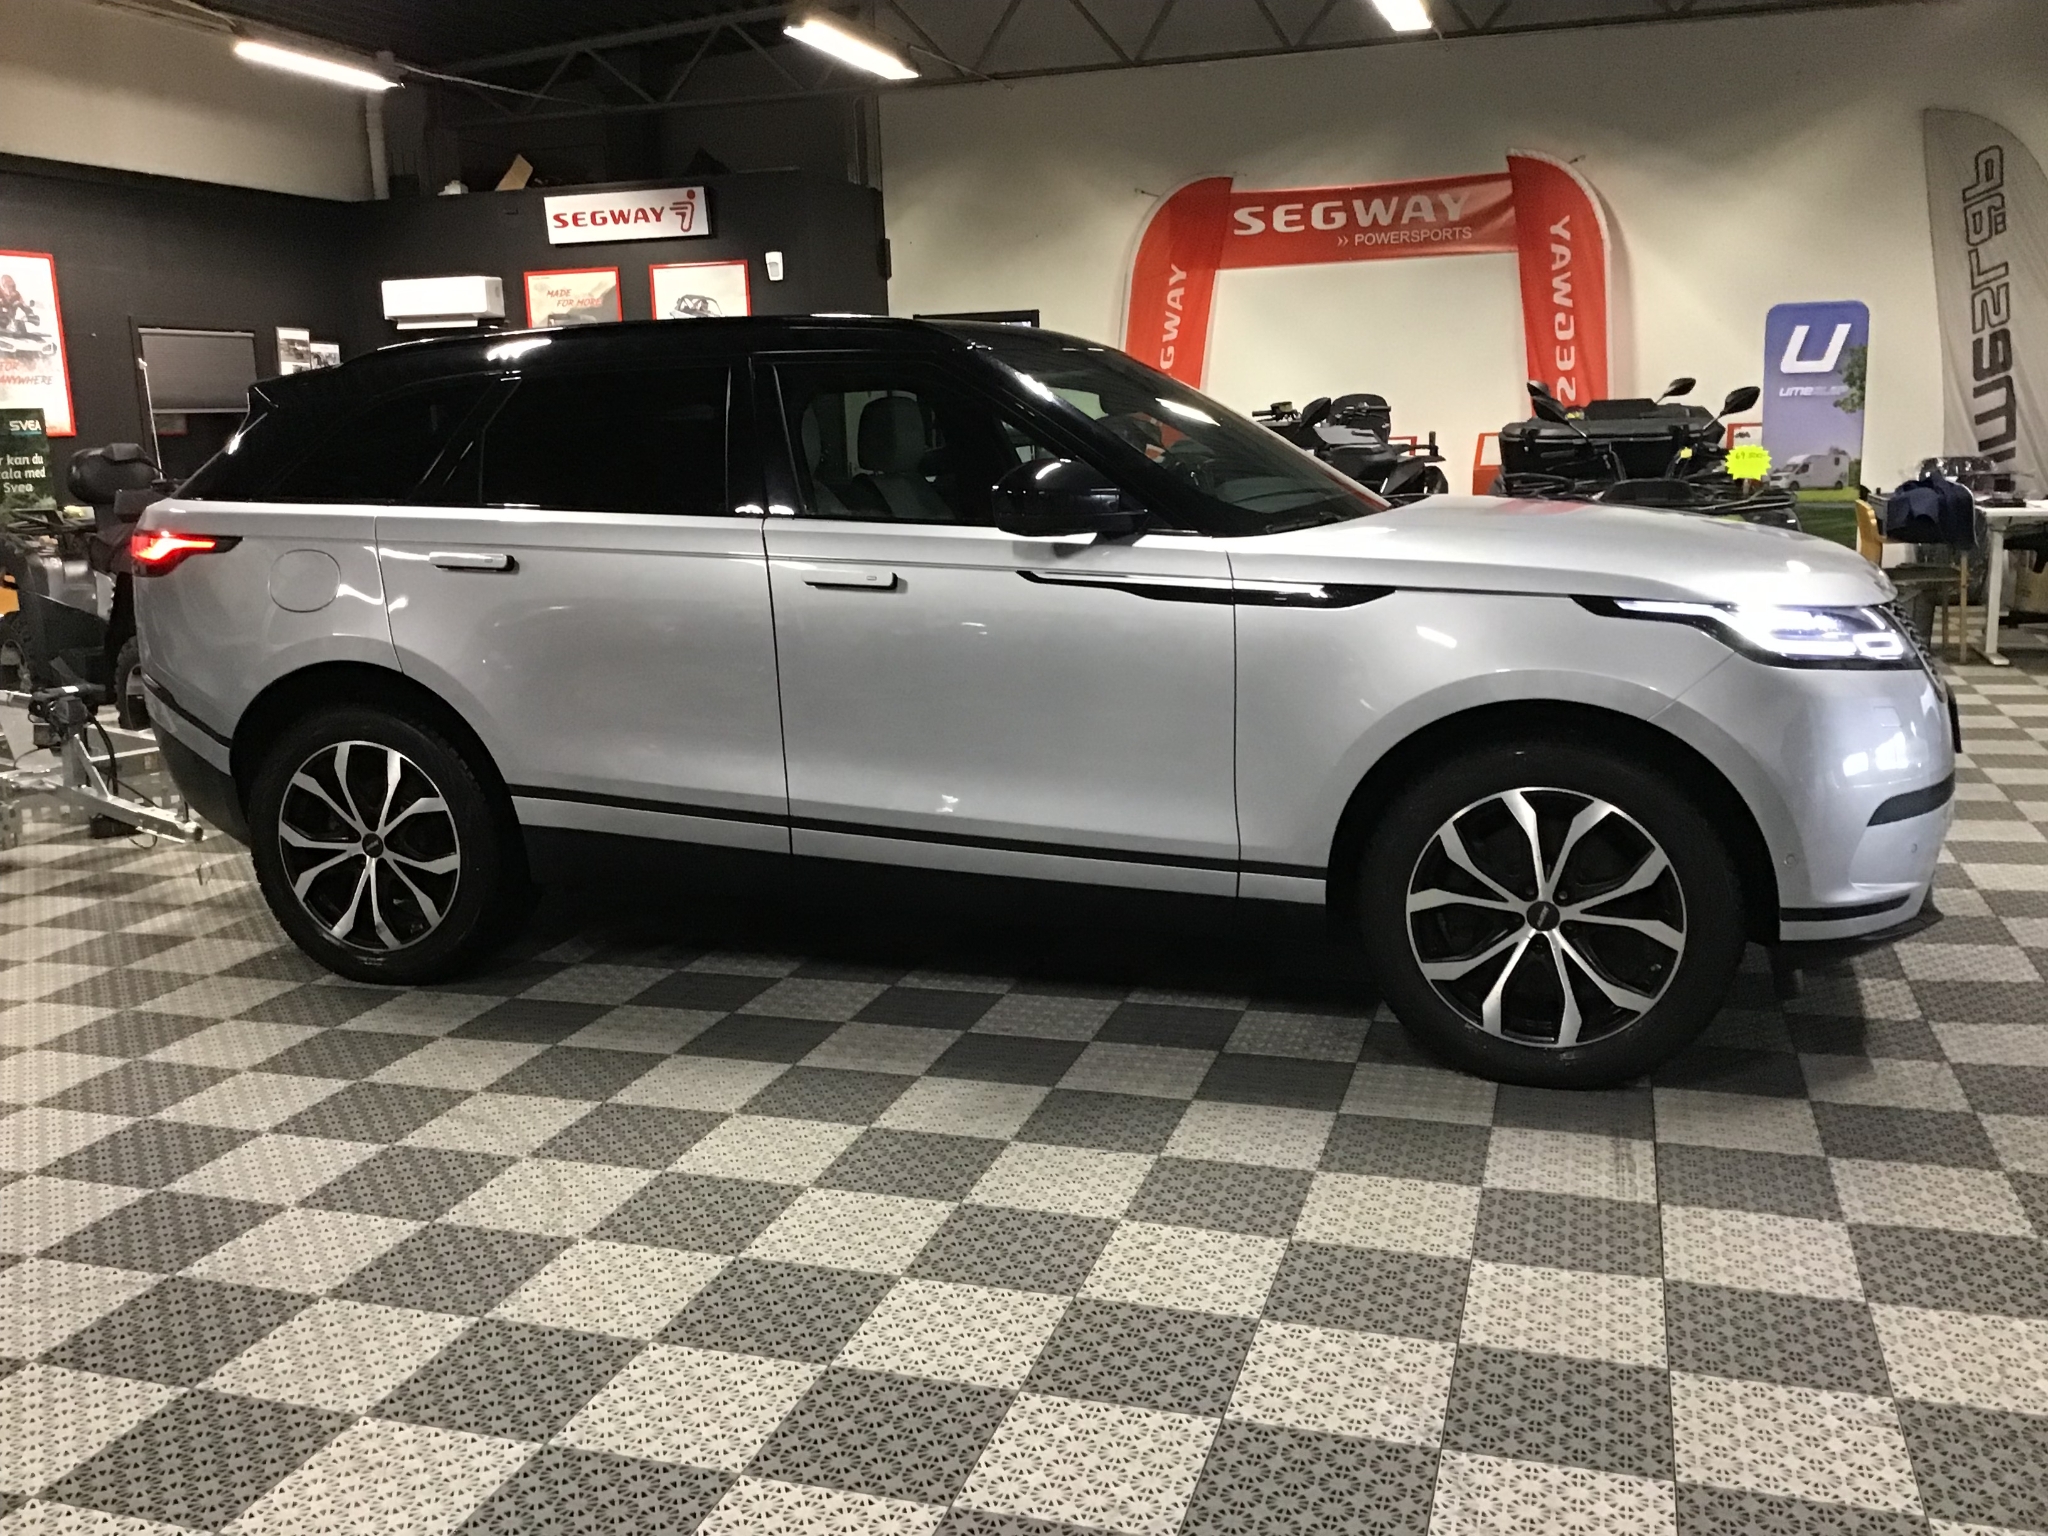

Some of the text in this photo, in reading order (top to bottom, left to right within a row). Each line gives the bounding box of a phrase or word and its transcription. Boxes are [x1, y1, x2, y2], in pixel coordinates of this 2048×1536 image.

[552, 206, 665, 229] SEGWAY
[1233, 193, 1471, 236] SEGWAY
[1354, 226, 1473, 247] POWERSPORTS
[547, 288, 572, 298] MADE
[556, 297, 602, 307] FOR MORE
[1159, 263, 1188, 371] GWAY
[1780, 323, 1852, 374] U
[9, 420, 42, 431] SVEA
[6, 453, 31, 466] kan
[31, 452, 44, 465] du
[24, 465, 47, 479] med
[3, 482, 34, 493] Svea
